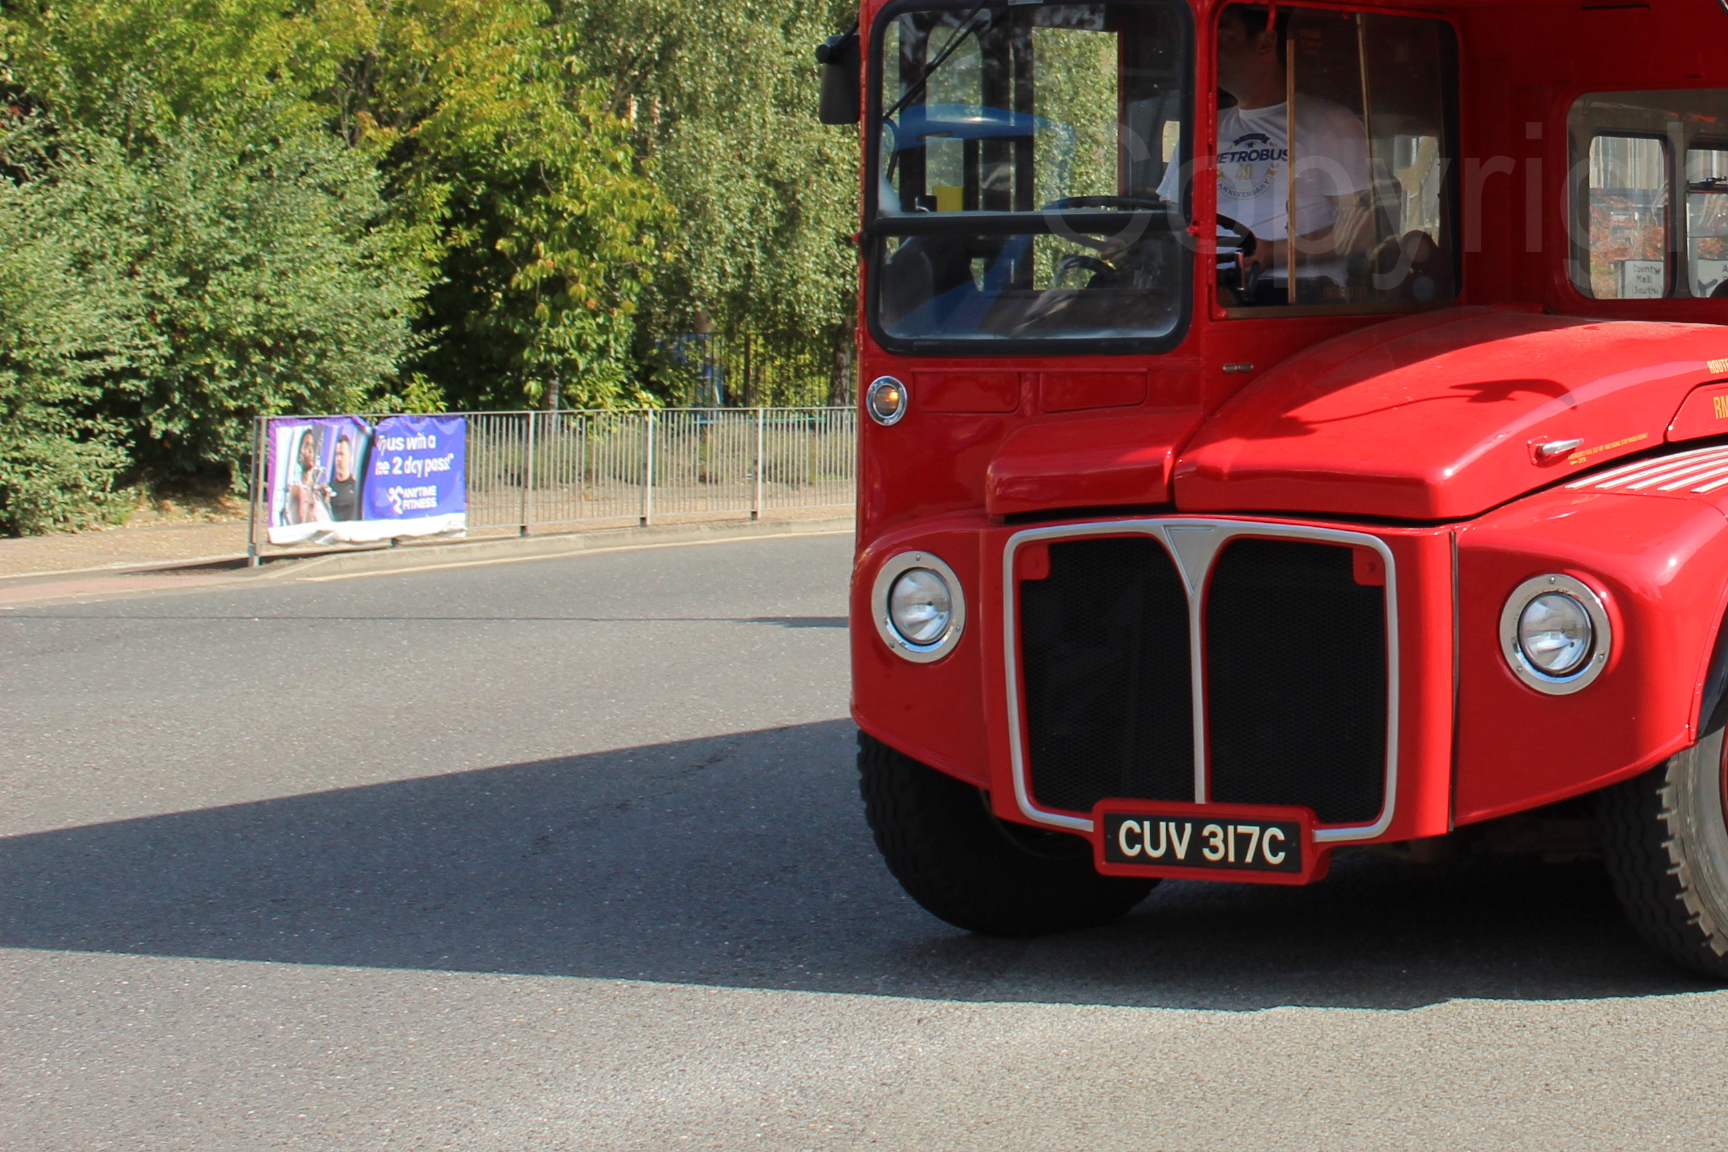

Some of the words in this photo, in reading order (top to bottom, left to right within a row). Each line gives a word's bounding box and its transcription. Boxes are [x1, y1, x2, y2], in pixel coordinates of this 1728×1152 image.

[1218, 179, 1269, 197] ANNIVERSARY
[387, 436, 405, 451] us
[391, 456, 403, 475] 2
[404, 455, 423, 478] day
[403, 485, 437, 498] ANYTIME
[403, 497, 437, 510] FITNESS
[1118, 820, 1192, 859] CUV
[1202, 824, 1286, 865] 317C
